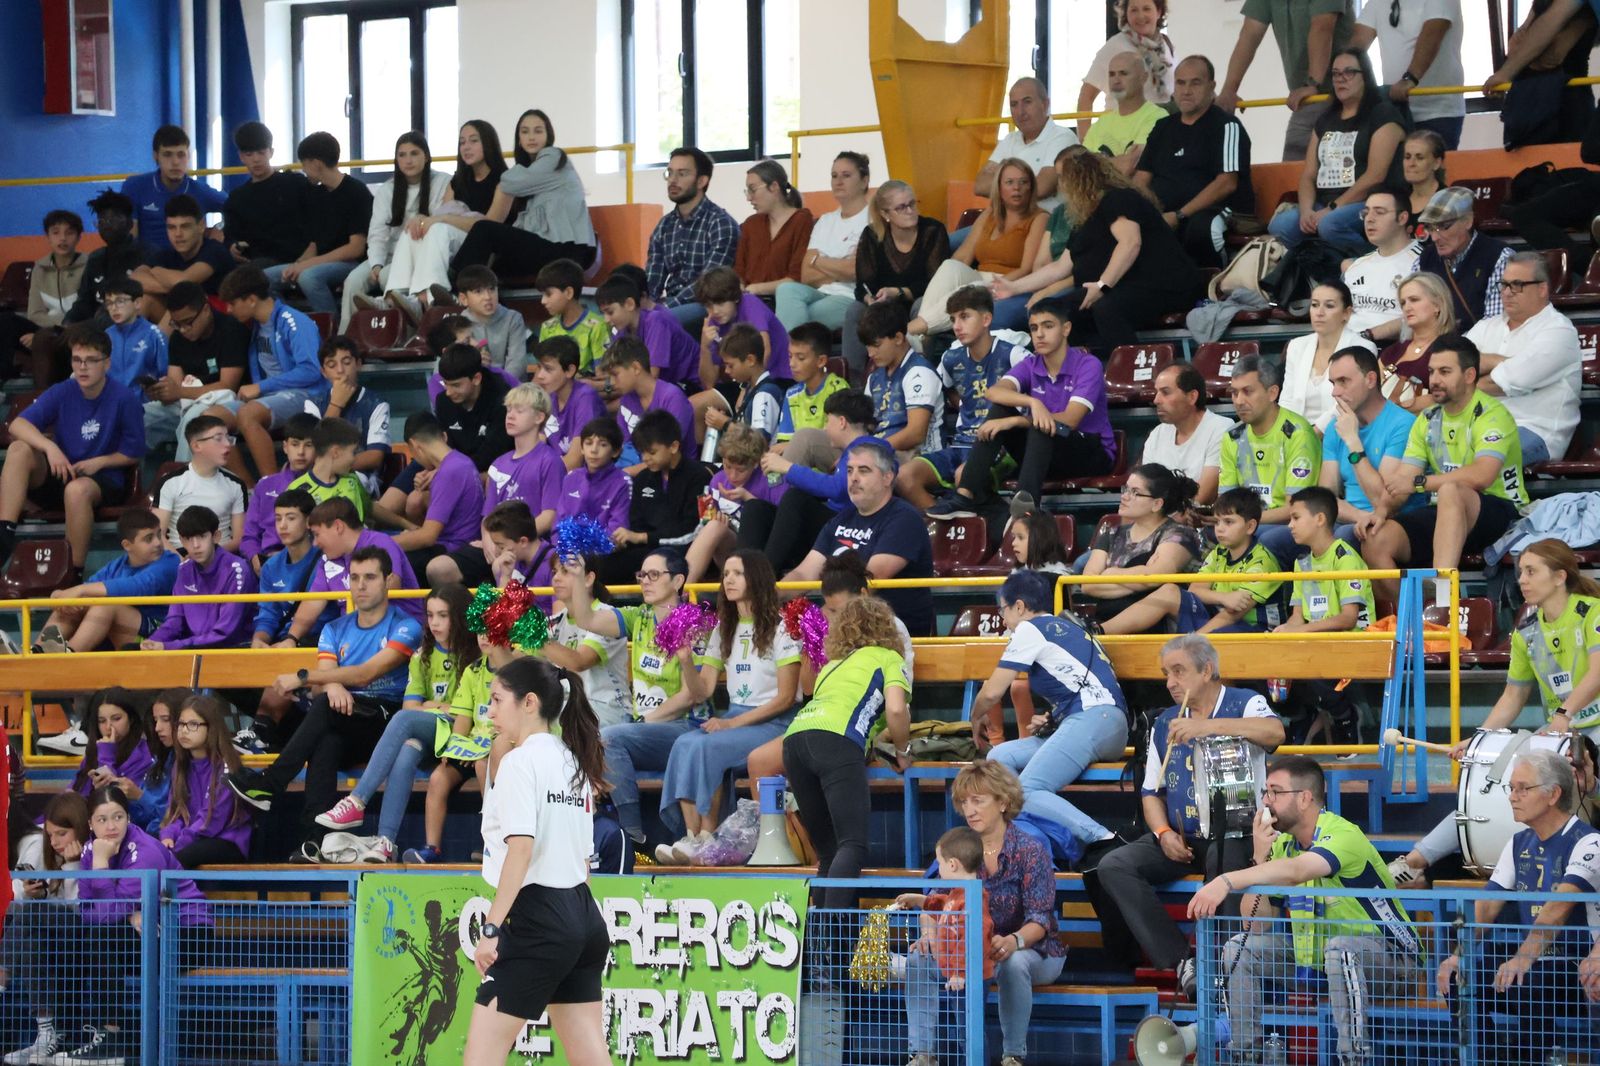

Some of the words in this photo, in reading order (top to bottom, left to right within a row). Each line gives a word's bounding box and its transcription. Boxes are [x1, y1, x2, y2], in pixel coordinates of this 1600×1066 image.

[370, 316, 387, 329] 64
[1133, 350, 1158, 368] 44
[1221, 350, 1241, 364] 42
[945, 525, 967, 541] 42
[35, 548, 51, 561] 62
[740, 638, 750, 660] 7
[735, 663, 752, 674] gaza
[547, 790, 585, 807] helveia
[602, 987, 798, 1061] IRIATO
